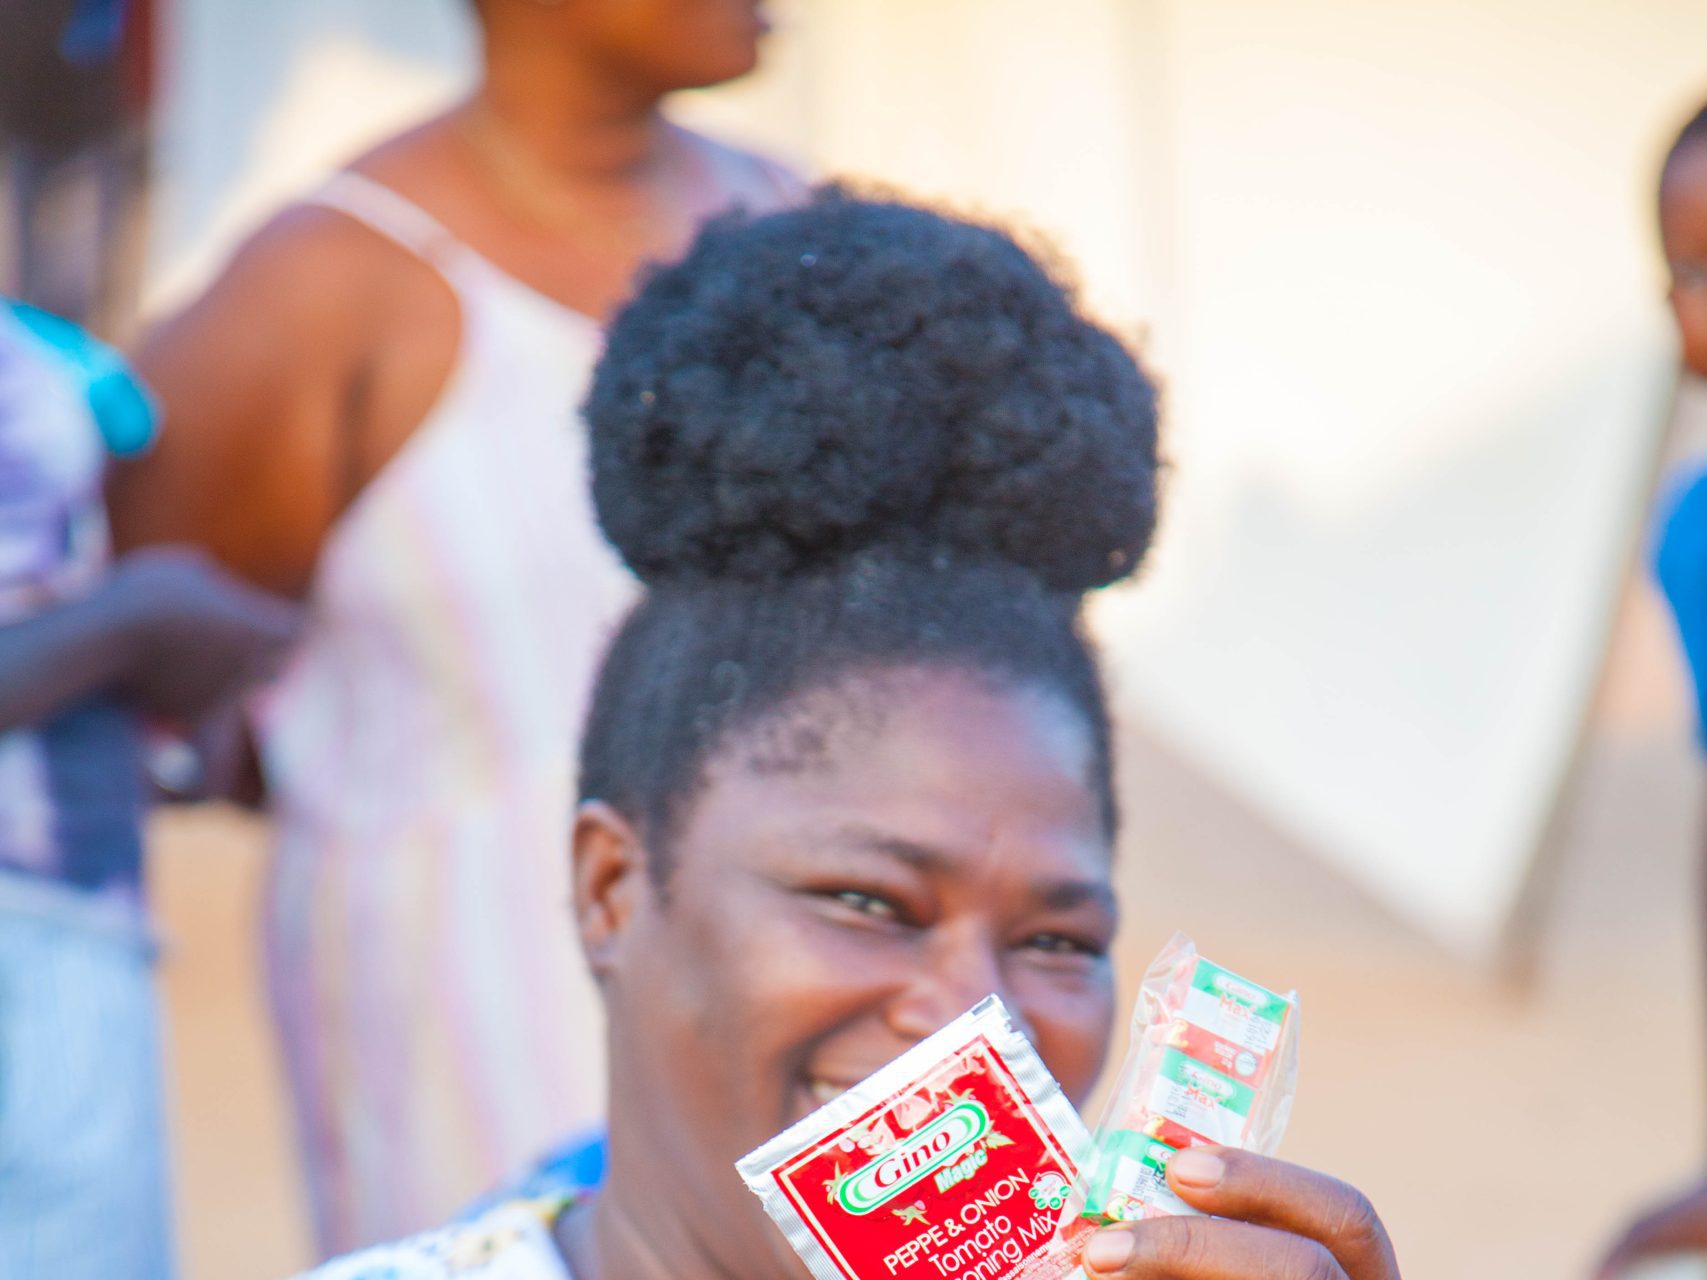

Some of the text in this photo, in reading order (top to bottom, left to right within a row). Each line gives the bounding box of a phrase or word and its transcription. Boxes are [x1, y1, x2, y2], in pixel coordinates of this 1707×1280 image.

[874, 1132, 949, 1187] Gino
[933, 1149, 988, 1193] Magic
[884, 1225, 947, 1274] PEPPE
[944, 1218, 965, 1236] &
[960, 1171, 1029, 1223] ONION
[929, 1215, 1010, 1275] Tomato
[1017, 1210, 1059, 1245] Mix
